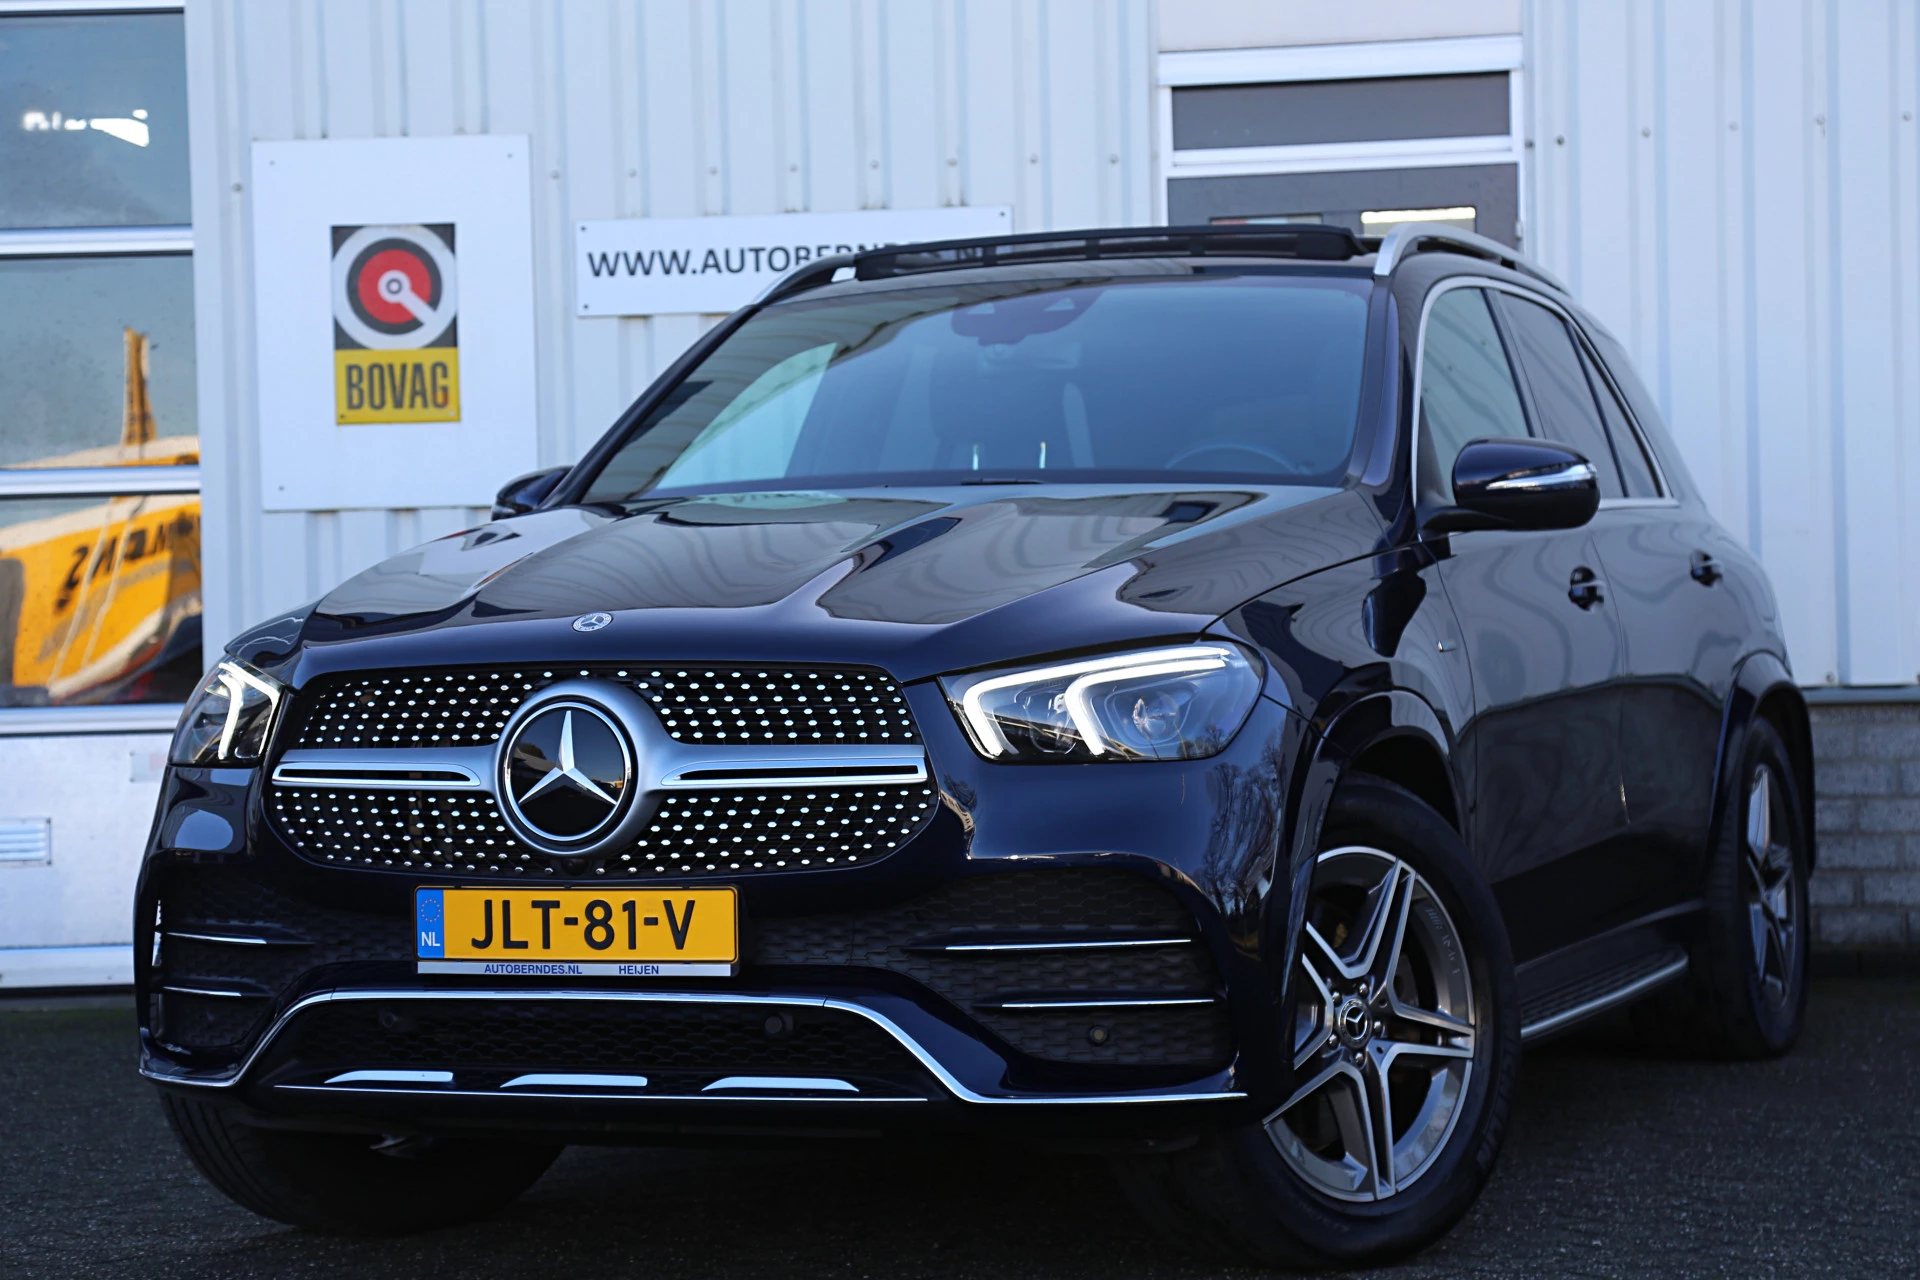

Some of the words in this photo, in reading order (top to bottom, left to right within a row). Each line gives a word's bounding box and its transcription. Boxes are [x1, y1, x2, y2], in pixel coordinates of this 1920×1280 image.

[346, 361, 449, 410] BOVAG
[421, 931, 441, 947] NL
[471, 899, 696, 951] JLT-81-V
[484, 963, 583, 976] AUTOBERNDES.NL
[618, 964, 660, 976] HEIJEN
